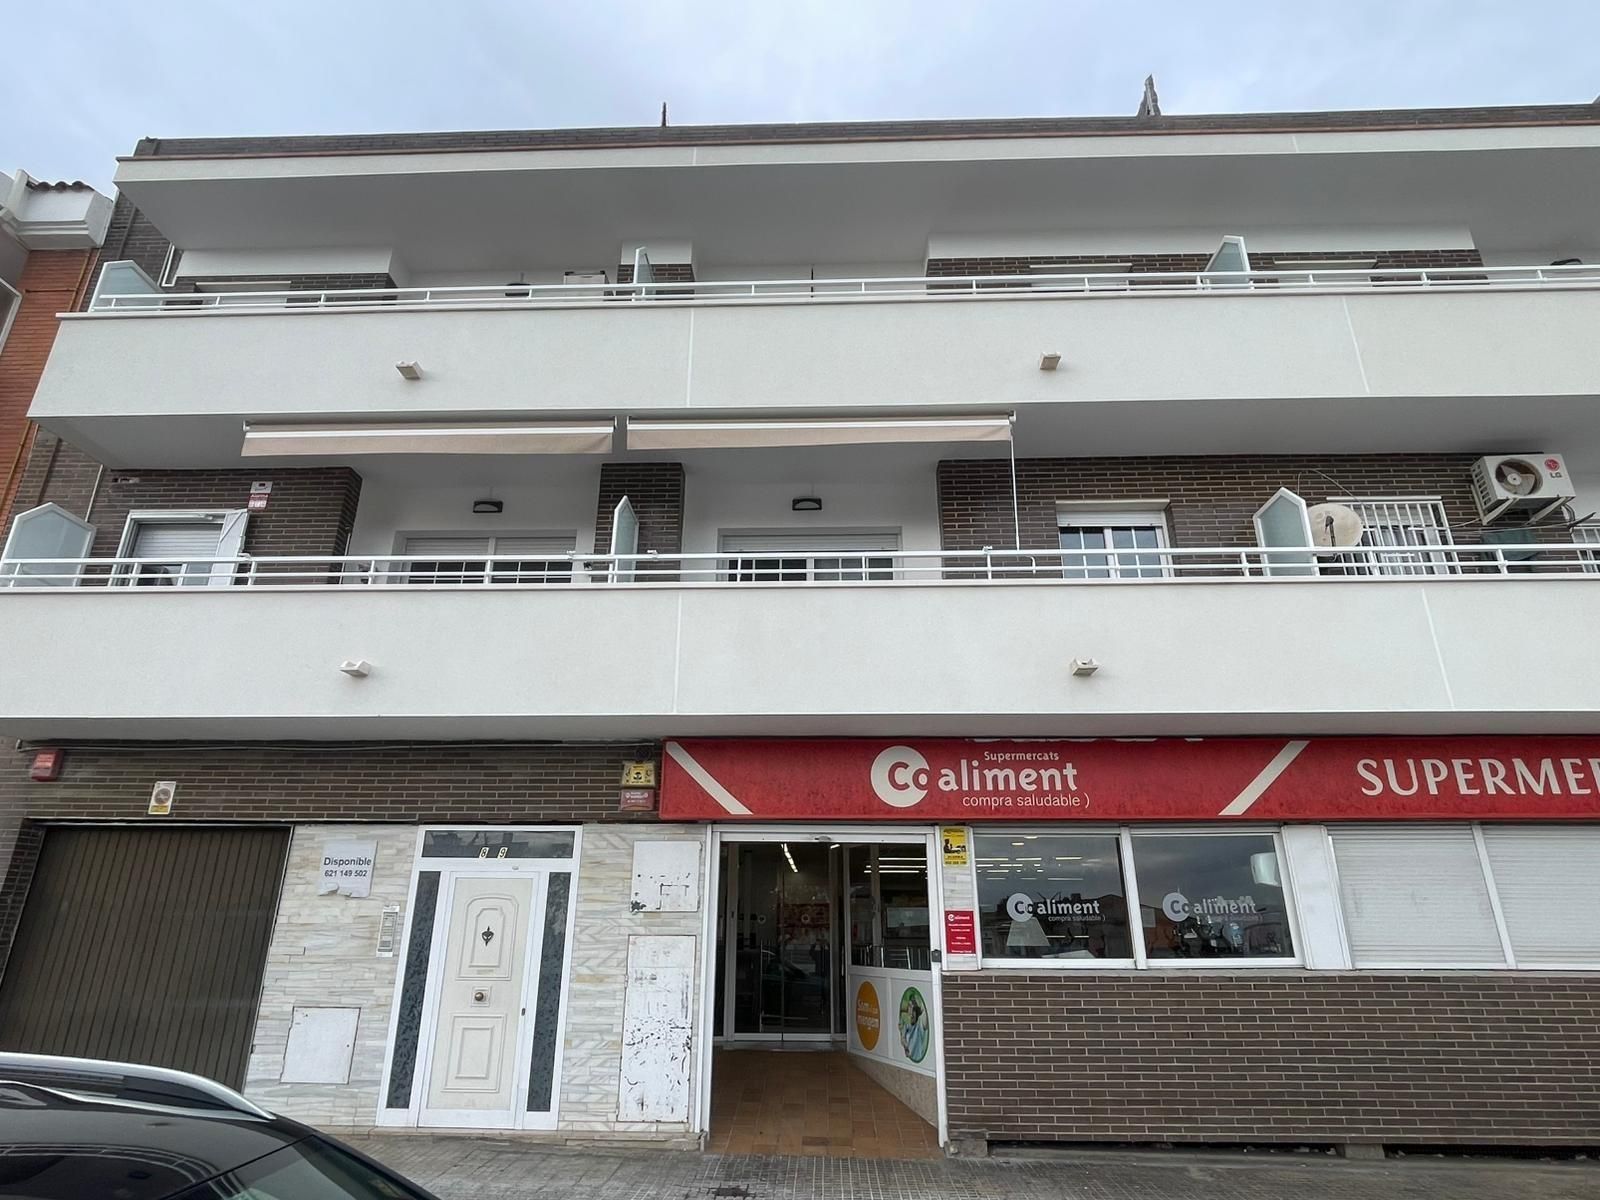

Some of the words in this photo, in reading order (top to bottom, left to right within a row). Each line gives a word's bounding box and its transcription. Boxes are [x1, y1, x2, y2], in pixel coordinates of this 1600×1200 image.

[984, 751, 1060, 763] Supermercats
[962, 797, 1013, 810] compra
[1016, 794, 1081, 807] saludable
[323, 857, 372, 867] Disponible
[324, 869, 338, 877] 621
[340, 869, 353, 877] 149
[354, 869, 368, 877] 502
